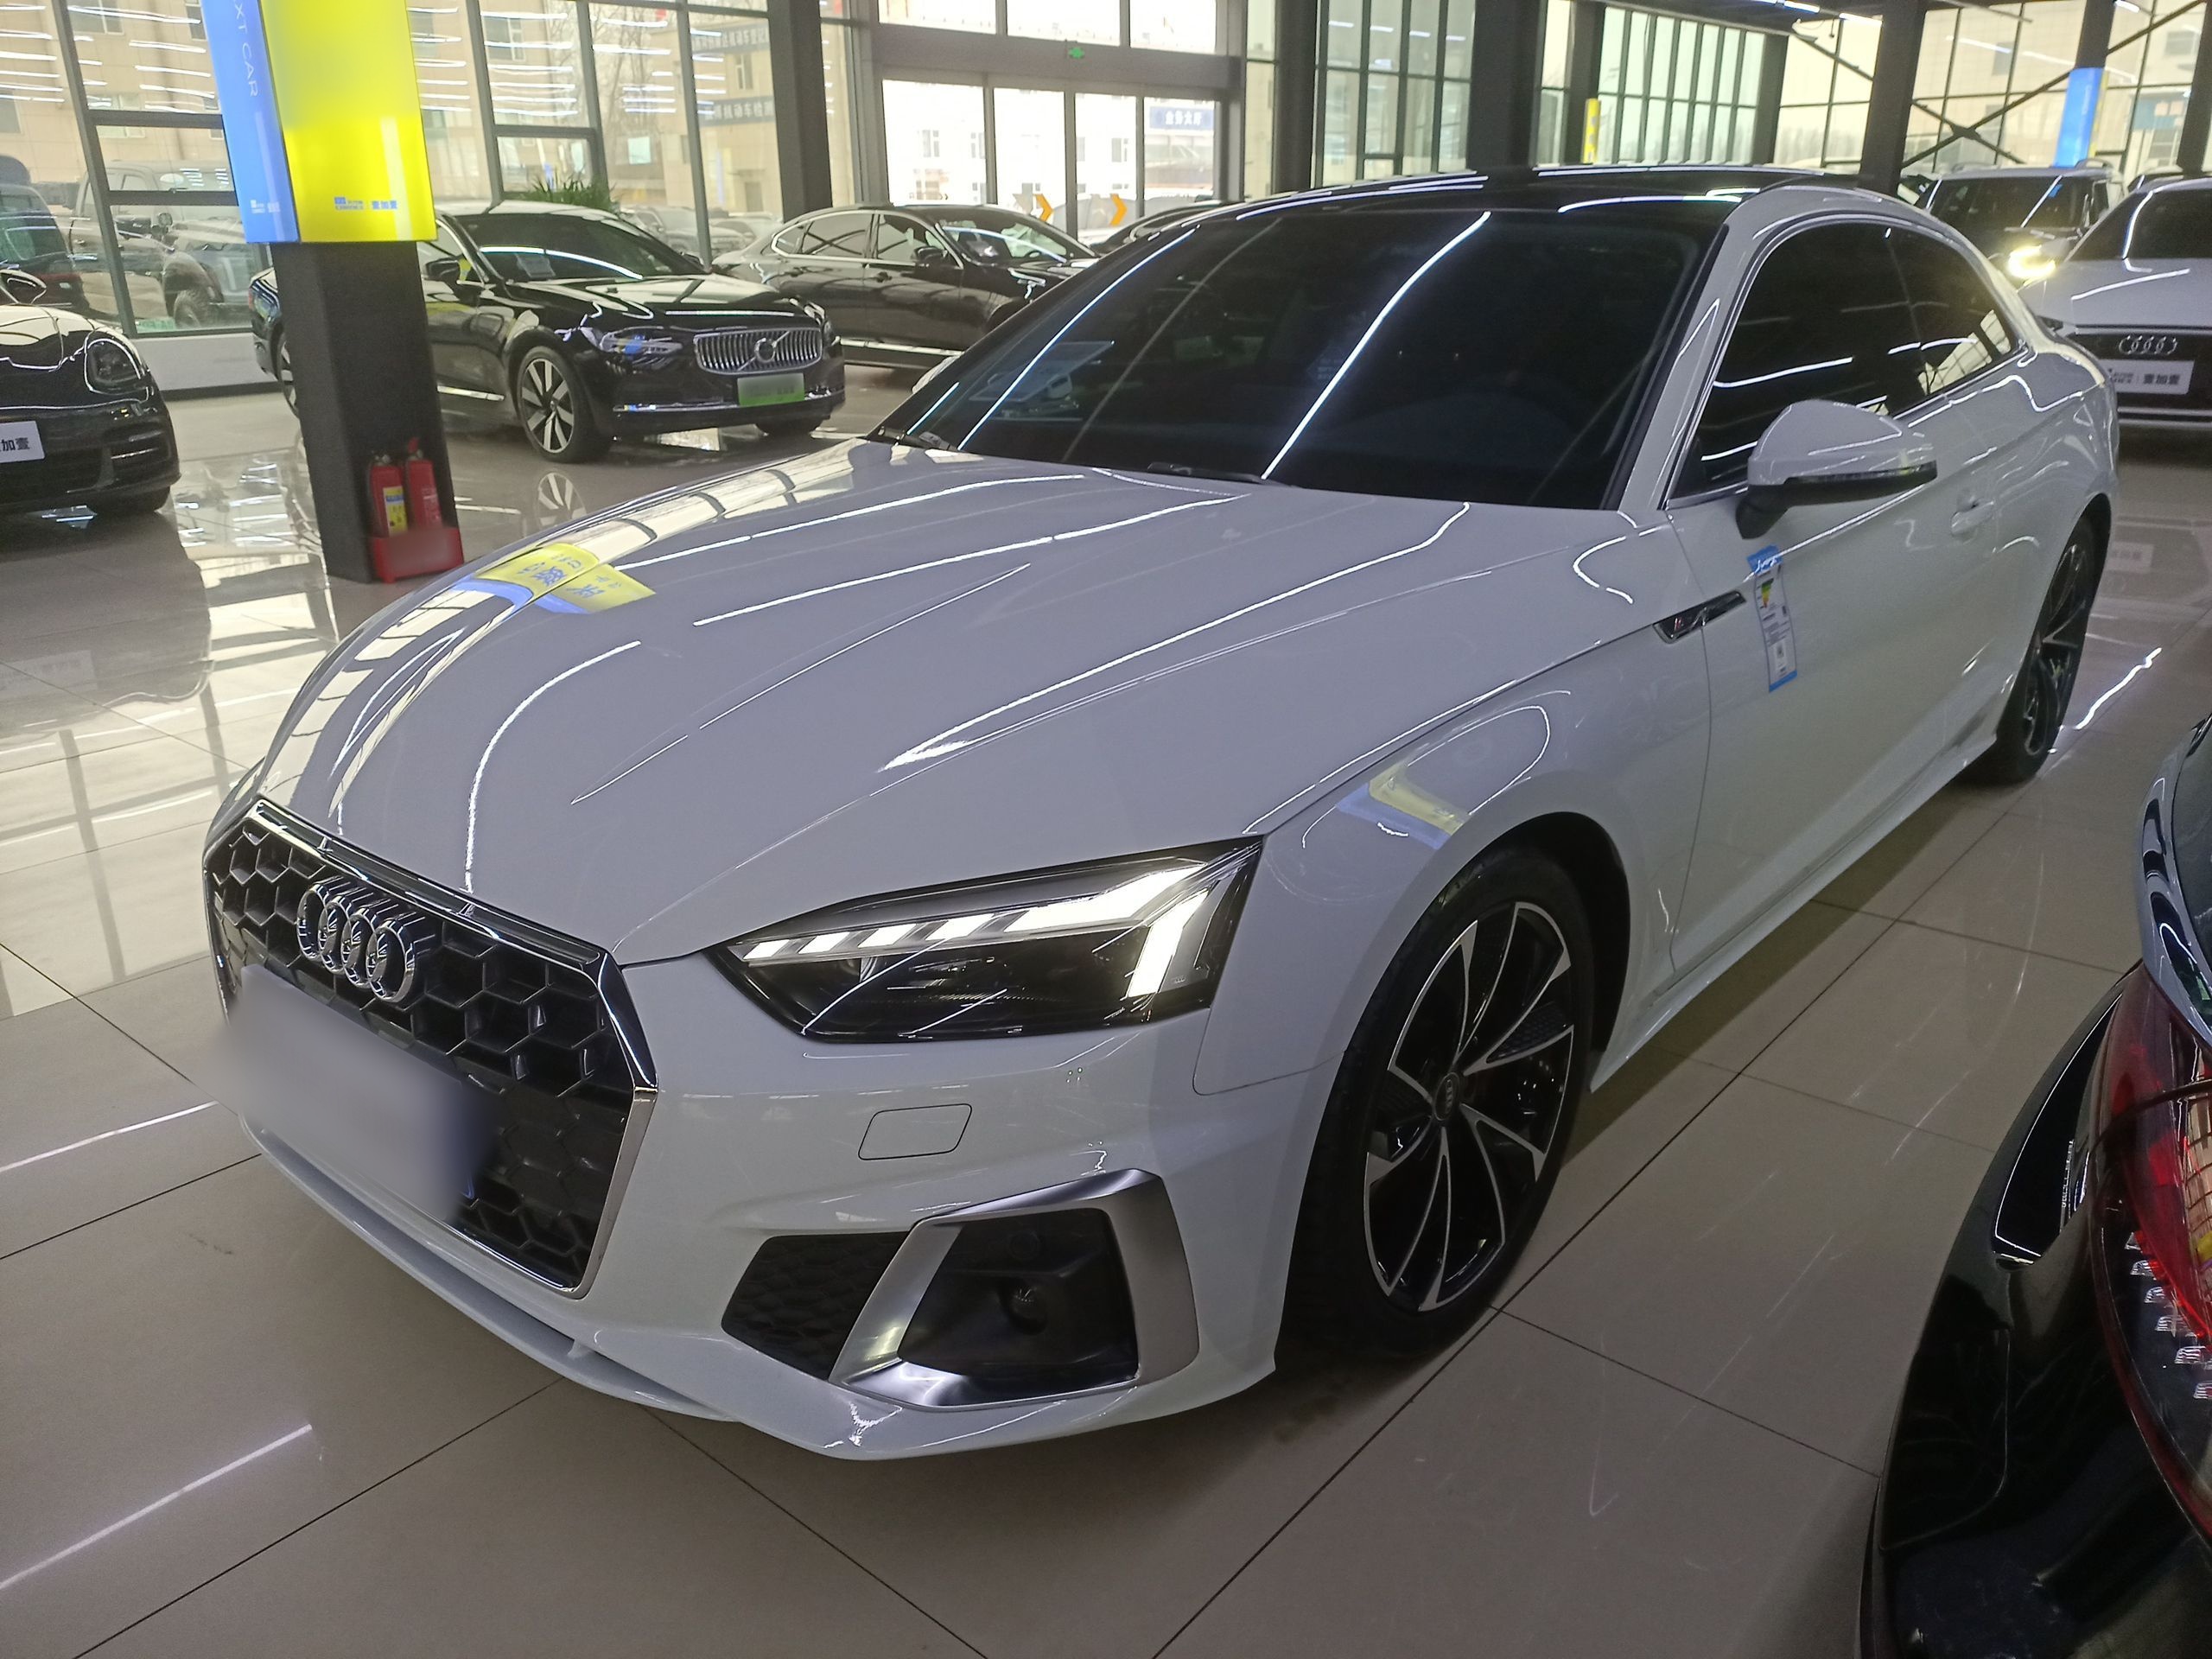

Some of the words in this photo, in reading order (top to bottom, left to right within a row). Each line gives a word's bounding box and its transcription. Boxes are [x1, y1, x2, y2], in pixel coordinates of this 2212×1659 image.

[242, 41, 258, 97] CAR
[2143, 373, 2180, 385] 壹加壹
[0, 437, 30, 451] 加壹
